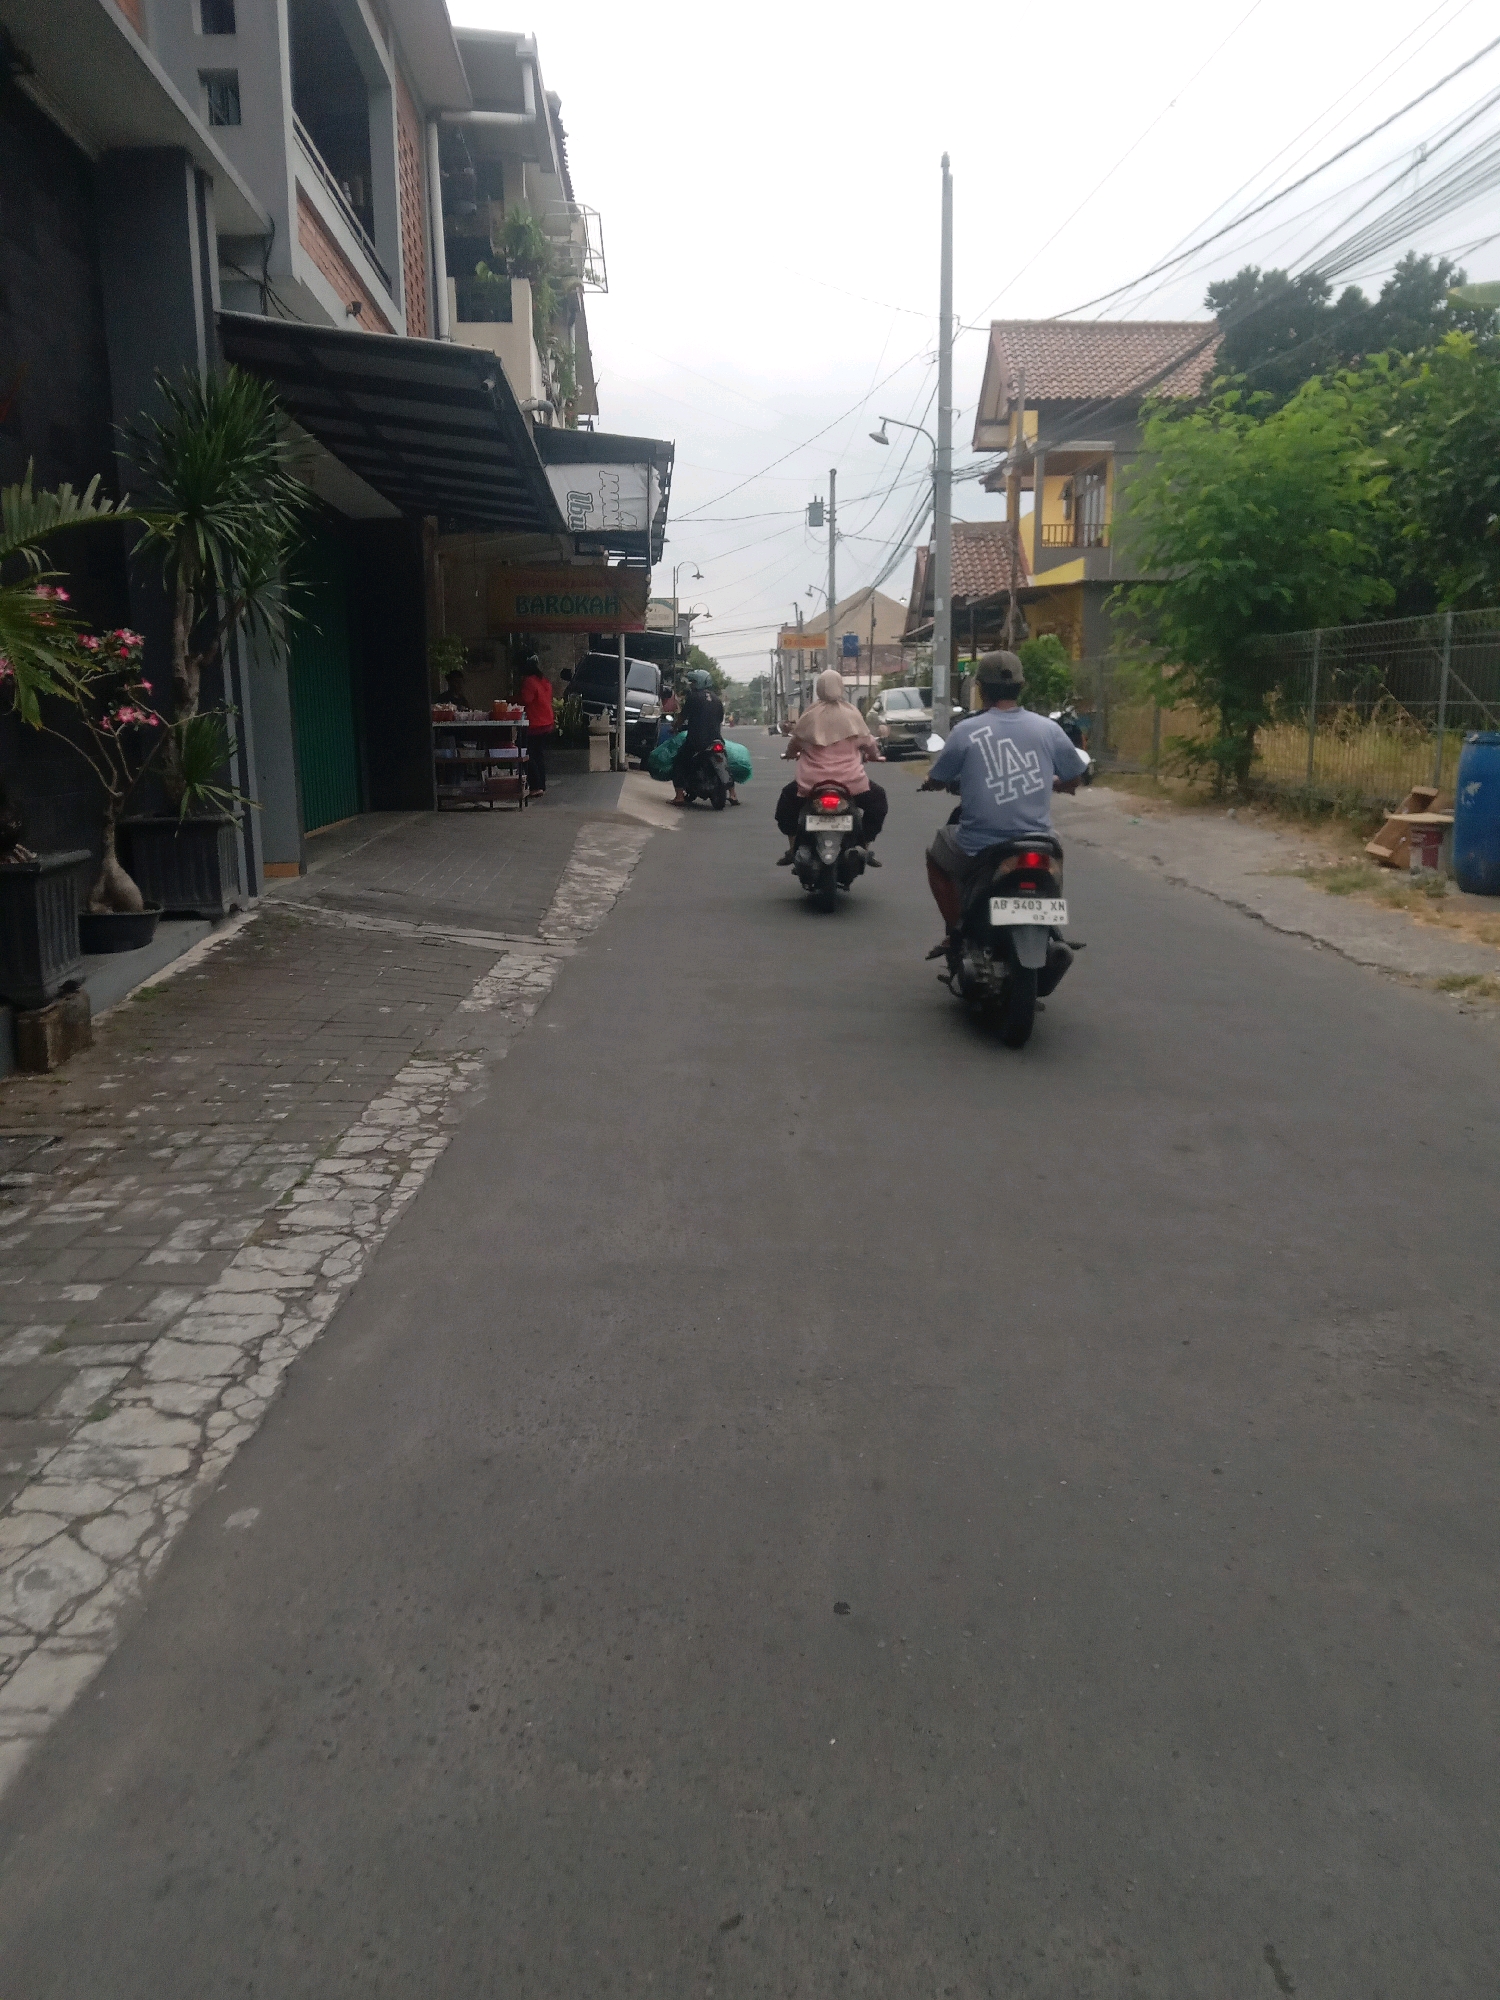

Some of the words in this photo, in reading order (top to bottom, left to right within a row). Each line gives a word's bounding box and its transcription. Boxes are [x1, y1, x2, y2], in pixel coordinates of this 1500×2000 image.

[516, 594, 620, 616] BAROKAH
[969, 726, 1044, 805] LA
[993, 900, 1008, 910] AB
[1013, 900, 1042, 911] 5403
[1050, 901, 1065, 912] XN
